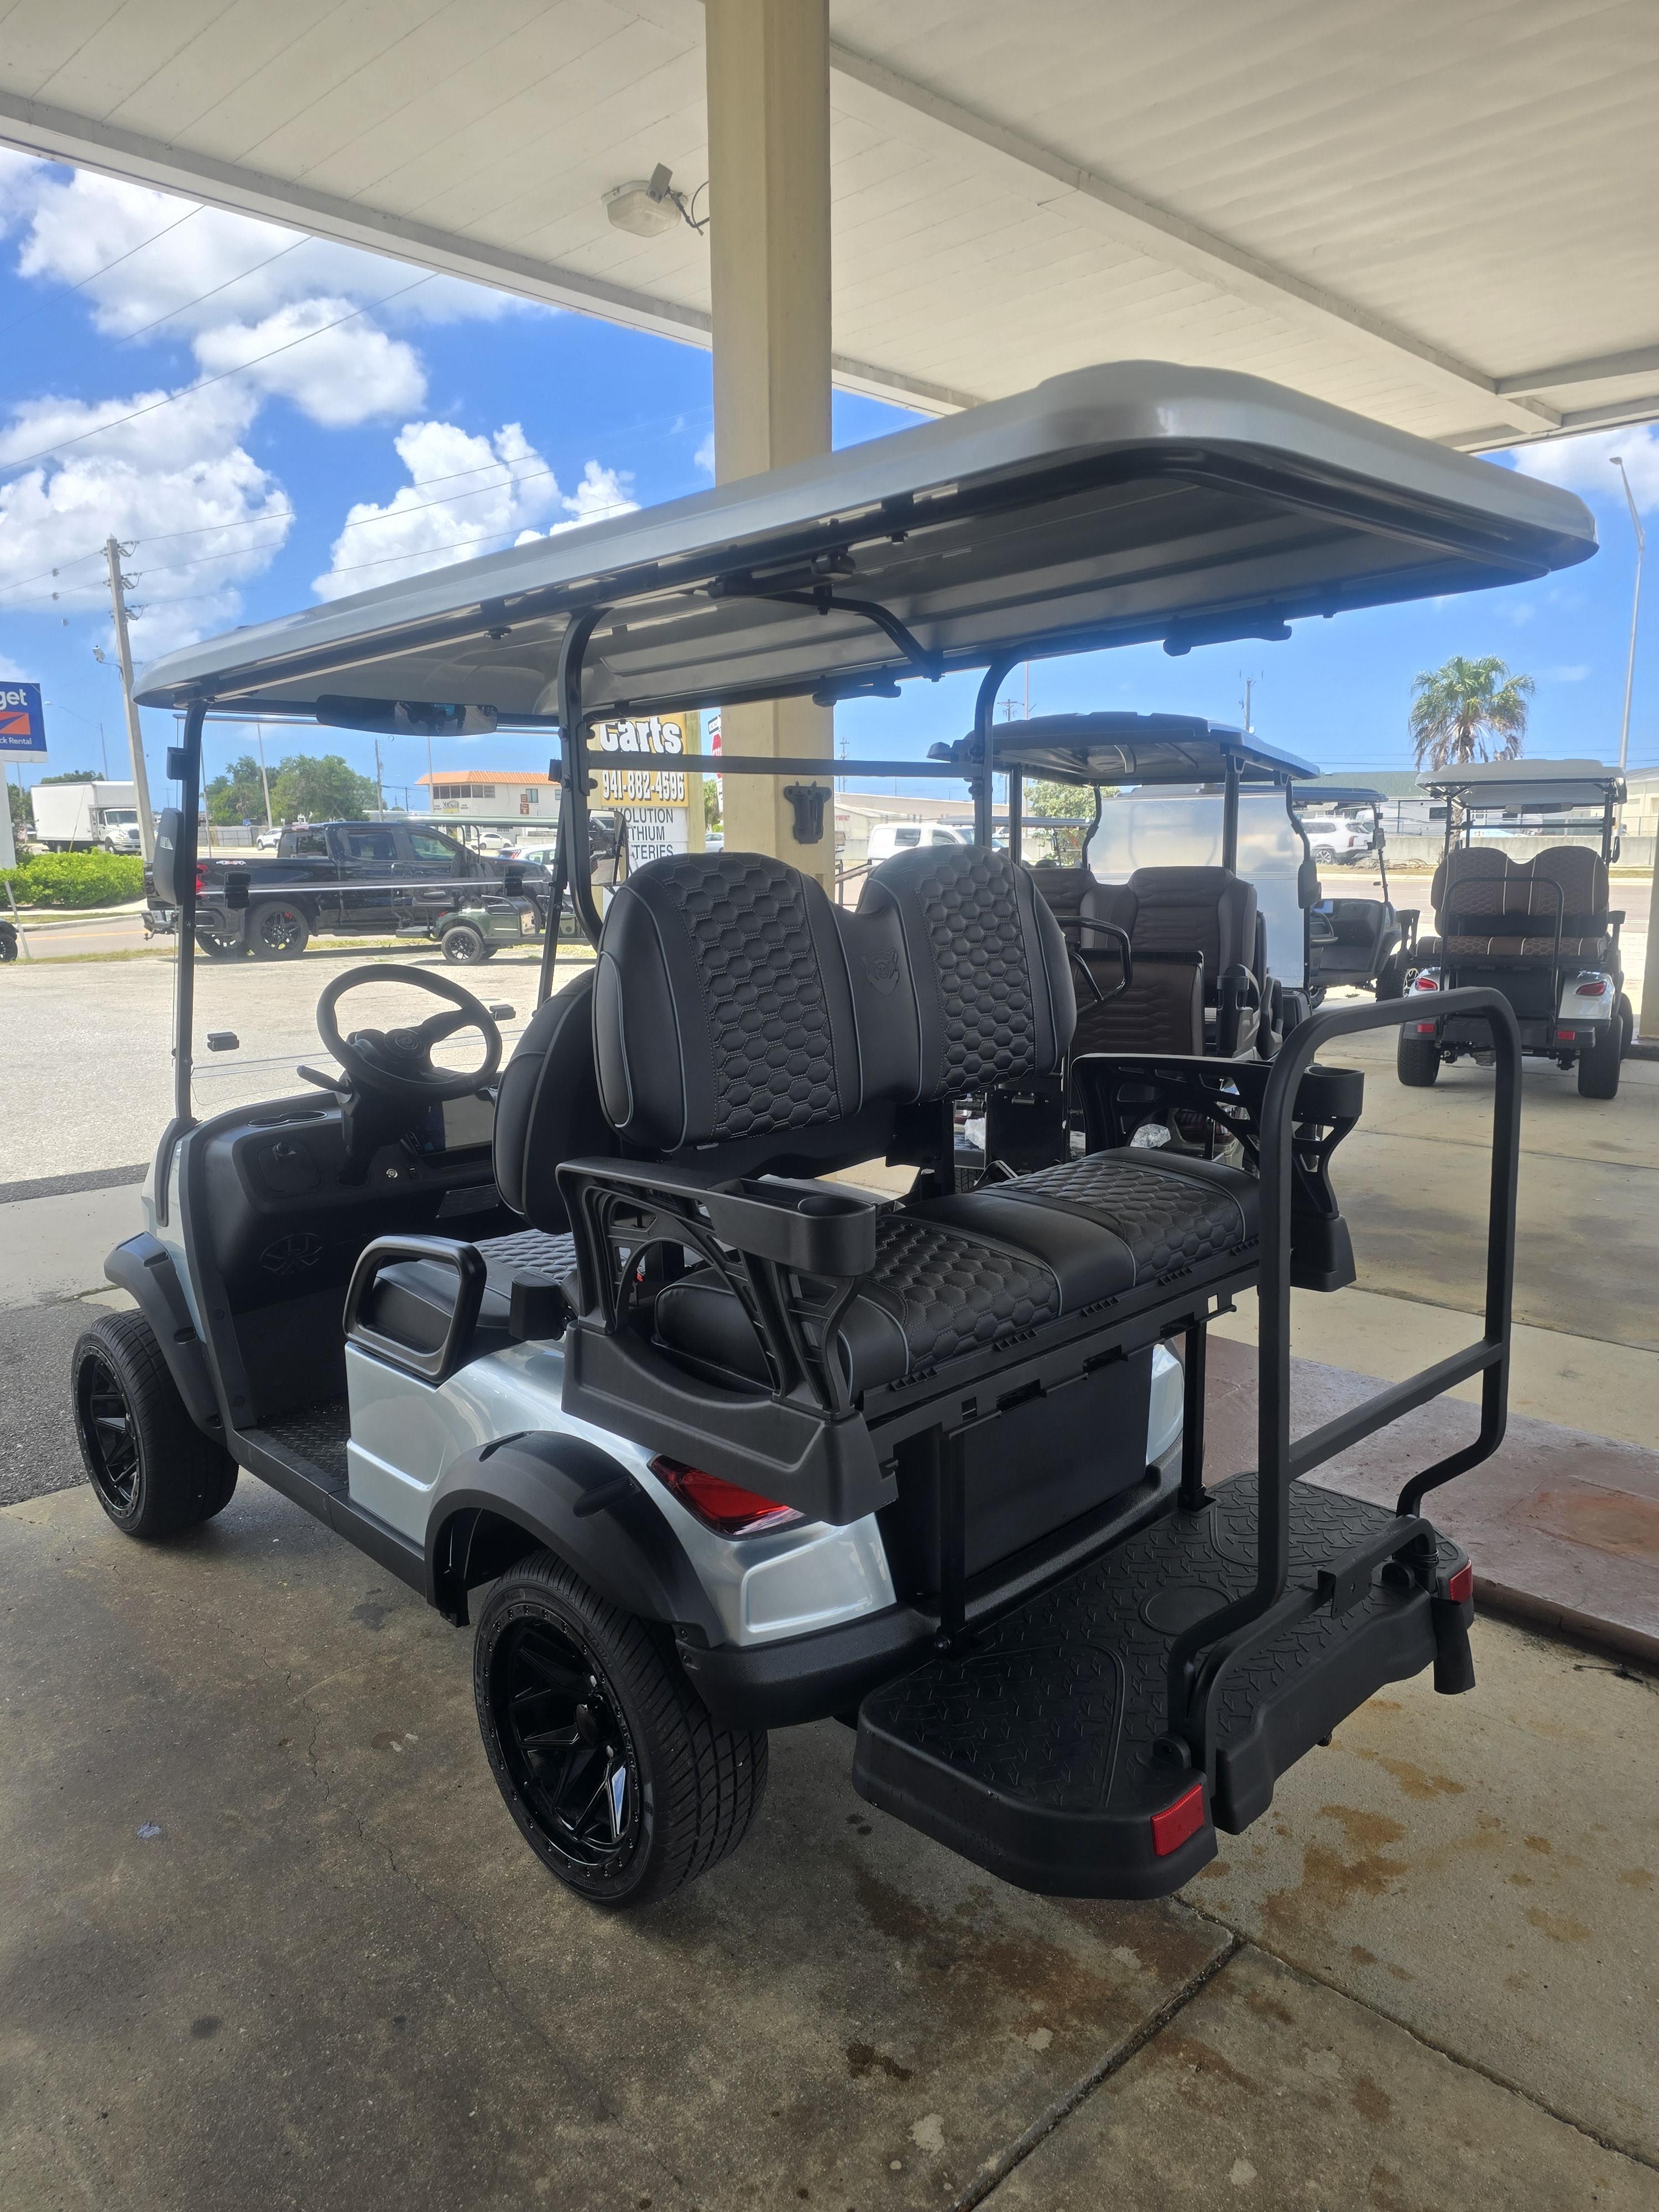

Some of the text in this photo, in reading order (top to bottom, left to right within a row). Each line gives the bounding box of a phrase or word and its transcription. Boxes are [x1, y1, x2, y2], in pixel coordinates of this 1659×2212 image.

[600, 717, 684, 754] Carts
[602, 770, 685, 801] 941-882-4596
[608, 807, 673, 823] OLUTION
